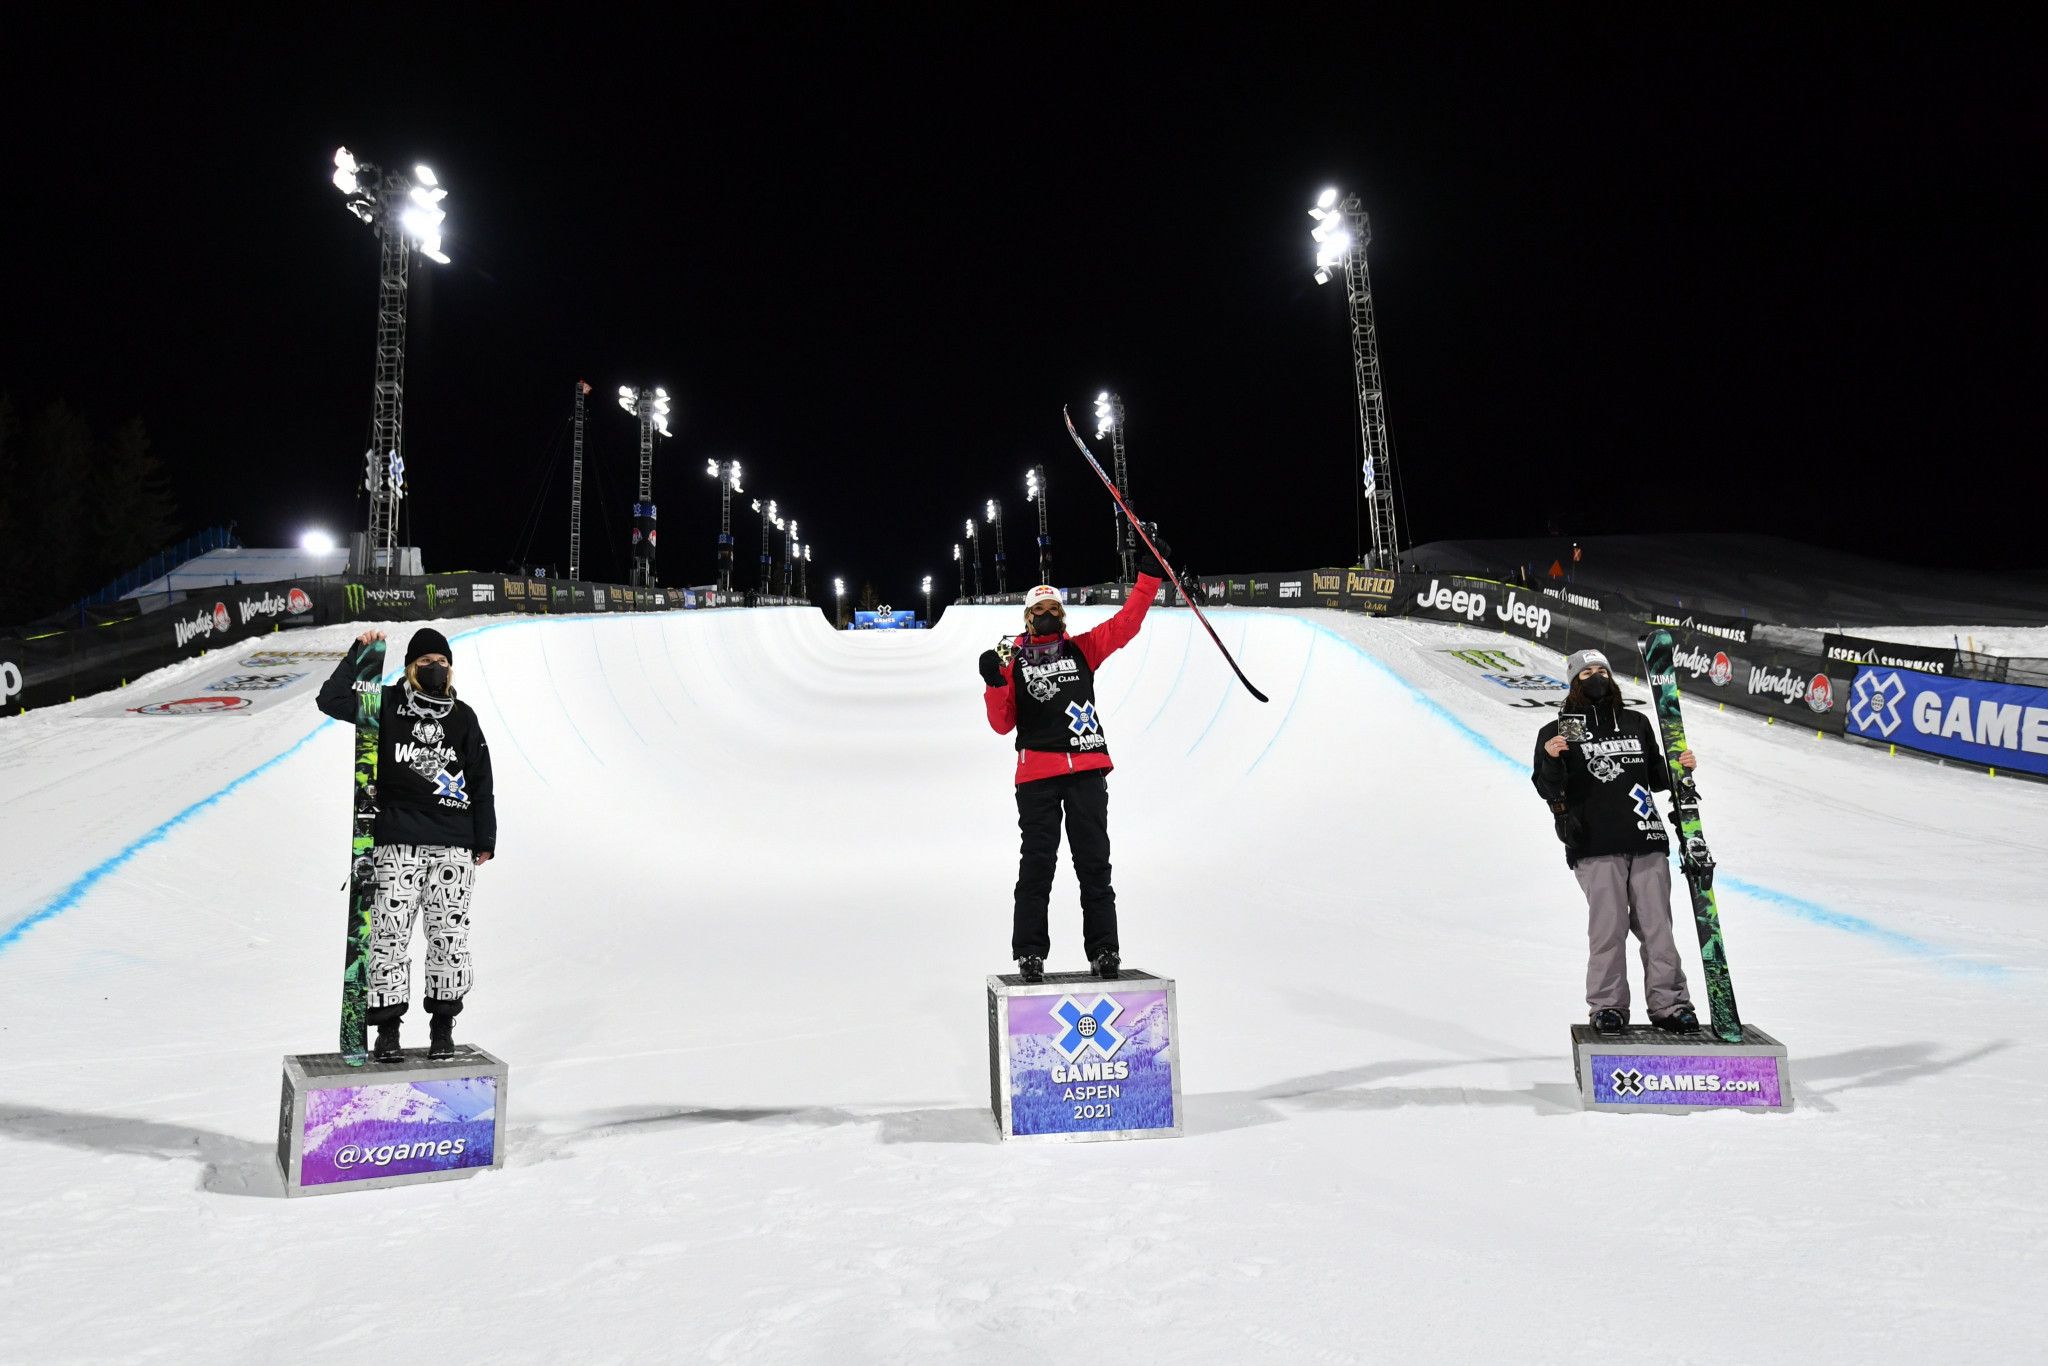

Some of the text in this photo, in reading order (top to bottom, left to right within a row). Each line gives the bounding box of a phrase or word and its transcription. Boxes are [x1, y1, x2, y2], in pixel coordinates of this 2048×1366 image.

[1345, 572, 1395, 594] PACIFICO
[366, 589, 416, 600] MONSTER
[1417, 579, 1486, 620] Jeep
[239, 591, 286, 625] Wendy's
[1496, 592, 1551, 637] Jeep
[174, 609, 214, 648] Wendy's
[356, 680, 381, 694] ZUMA
[1650, 674, 1677, 687] ZUMA
[1748, 665, 1806, 705] Wendy's
[1580, 739, 1642, 760] PACIFICO
[1621, 756, 1645, 764] CLARA
[1051, 1061, 1129, 1084] GAMES
[1062, 1084, 1120, 1102] ASPEN
[1073, 1104, 1112, 1120] 2021
[334, 1137, 466, 1170] @xgames
